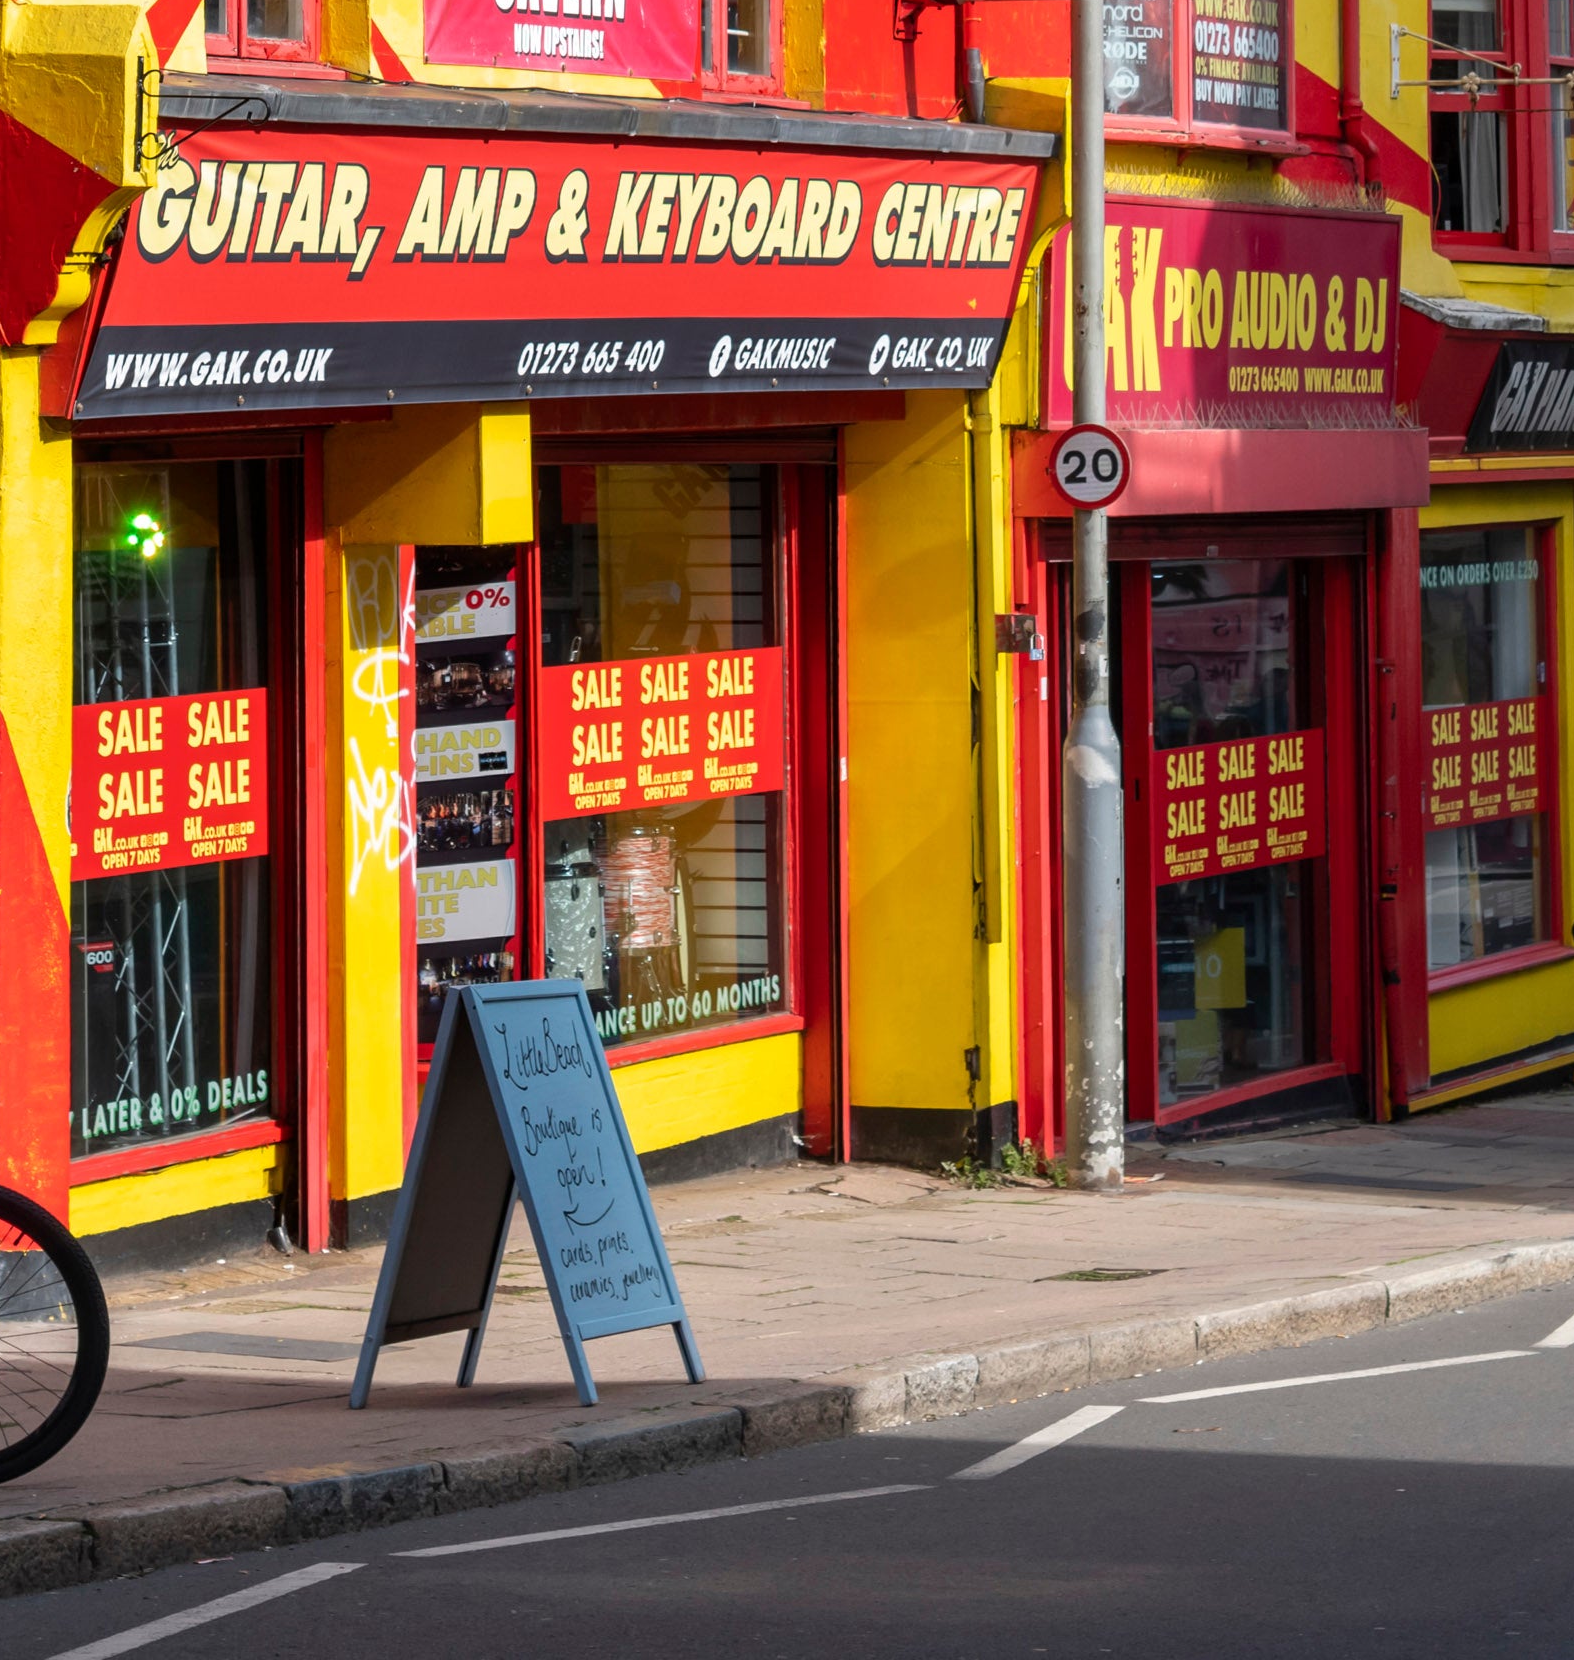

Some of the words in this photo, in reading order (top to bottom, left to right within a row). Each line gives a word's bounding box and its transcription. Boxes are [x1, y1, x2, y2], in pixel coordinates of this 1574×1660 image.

[1103, 3, 1143, 22] nord
[513, 23, 542, 56] NOW
[543, 25, 605, 61] UPSTAIRS!
[1195, 20, 1230, 56] 01273
[1233, 25, 1279, 62] 665400
[1195, 56, 1208, 76] 0%
[1209, 57, 1240, 81] FINANCE
[1241, 62, 1279, 85] AVAILABLE
[1195, 78, 1212, 103] BUY
[1214, 80, 1235, 105] NOW
[1236, 83, 1252, 107] PAY
[1253, 86, 1279, 110] LATER!
[136, 158, 385, 281] GUITAR,
[392, 165, 537, 264] AMP
[544, 168, 590, 264] &
[601, 171, 863, 266] KEYBOARD
[872, 181, 1027, 269] CENTRE
[1163, 267, 1223, 350] PRO
[1229, 271, 1317, 352] AUDIO
[1324, 275, 1346, 352] &
[1354, 277, 1388, 354] DJ
[105, 347, 334, 390] WWW.GAK.CO.UK
[517, 341, 580, 375] 01273
[581, 341, 623, 374] 665
[625, 339, 665, 372] 400
[734, 337, 837, 371] GAKMUSIC
[891, 337, 995, 372] GAK_CO_UK
[1229, 366, 1259, 392] 01273
[1261, 366, 1299, 392] 665400
[1303, 367, 1385, 394] WWW.GAK.CO.UK
[1490, 361, 1550, 433] GAK
[1062, 448, 1119, 485] 20
[1439, 564, 1455, 586] ON
[1456, 562, 1490, 586] ORDERS
[1492, 560, 1515, 583] OVER
[465, 586, 510, 610] 0%
[571, 667, 622, 711] SALE
[640, 661, 689, 704] SALE
[706, 656, 754, 699] SALE
[97, 706, 164, 758] SALE
[187, 698, 250, 748] SALE
[417, 727, 501, 754] HAND
[572, 722, 623, 766] SALE
[641, 715, 690, 758] SALE
[707, 708, 754, 751] SALE
[1431, 711, 1461, 747] SALE
[1470, 706, 1499, 741] SALE
[1507, 703, 1536, 737] SALE
[1166, 750, 1205, 790] SALE
[1218, 743, 1255, 782] SALE
[1268, 736, 1304, 775] SALE
[1432, 755, 1462, 791] SALE
[1471, 749, 1499, 785] SALE
[1508, 745, 1536, 779] SALE
[98, 767, 164, 820] SALE
[188, 758, 250, 810] SALE
[575, 794, 595, 810] OPEN
[601, 791, 621, 806] DAYS
[643, 785, 663, 801] OPEN
[670, 782, 688, 797] DAYS
[710, 778, 729, 793] OPEN
[735, 775, 753, 790] DAYS
[1167, 798, 1206, 839] SALE
[1219, 791, 1256, 830] SALE
[1269, 783, 1305, 822] SALE
[101, 852, 127, 870] OPEN
[129, 850, 136, 866] 7
[137, 848, 161, 865] DAYS
[191, 840, 217, 858] OPEN
[218, 839, 224, 854] 7
[225, 836, 248, 853] DAYS
[417, 866, 498, 893] THAN
[86, 950, 114, 966] 600
[641, 999, 662, 1030] UP
[667, 995, 687, 1025] TO
[692, 990, 712, 1019] 60
[716, 974, 780, 1013] MONTHS
[494, 1022, 546, 1091] Little
[542, 1017, 593, 1079] Beach
[82, 1097, 143, 1139] LATER
[150, 1092, 164, 1126] &
[171, 1085, 201, 1120] 0%
[207, 1069, 268, 1114] DEALS
[520, 1105, 584, 1163] Boutique
[591, 1107, 603, 1133] is
